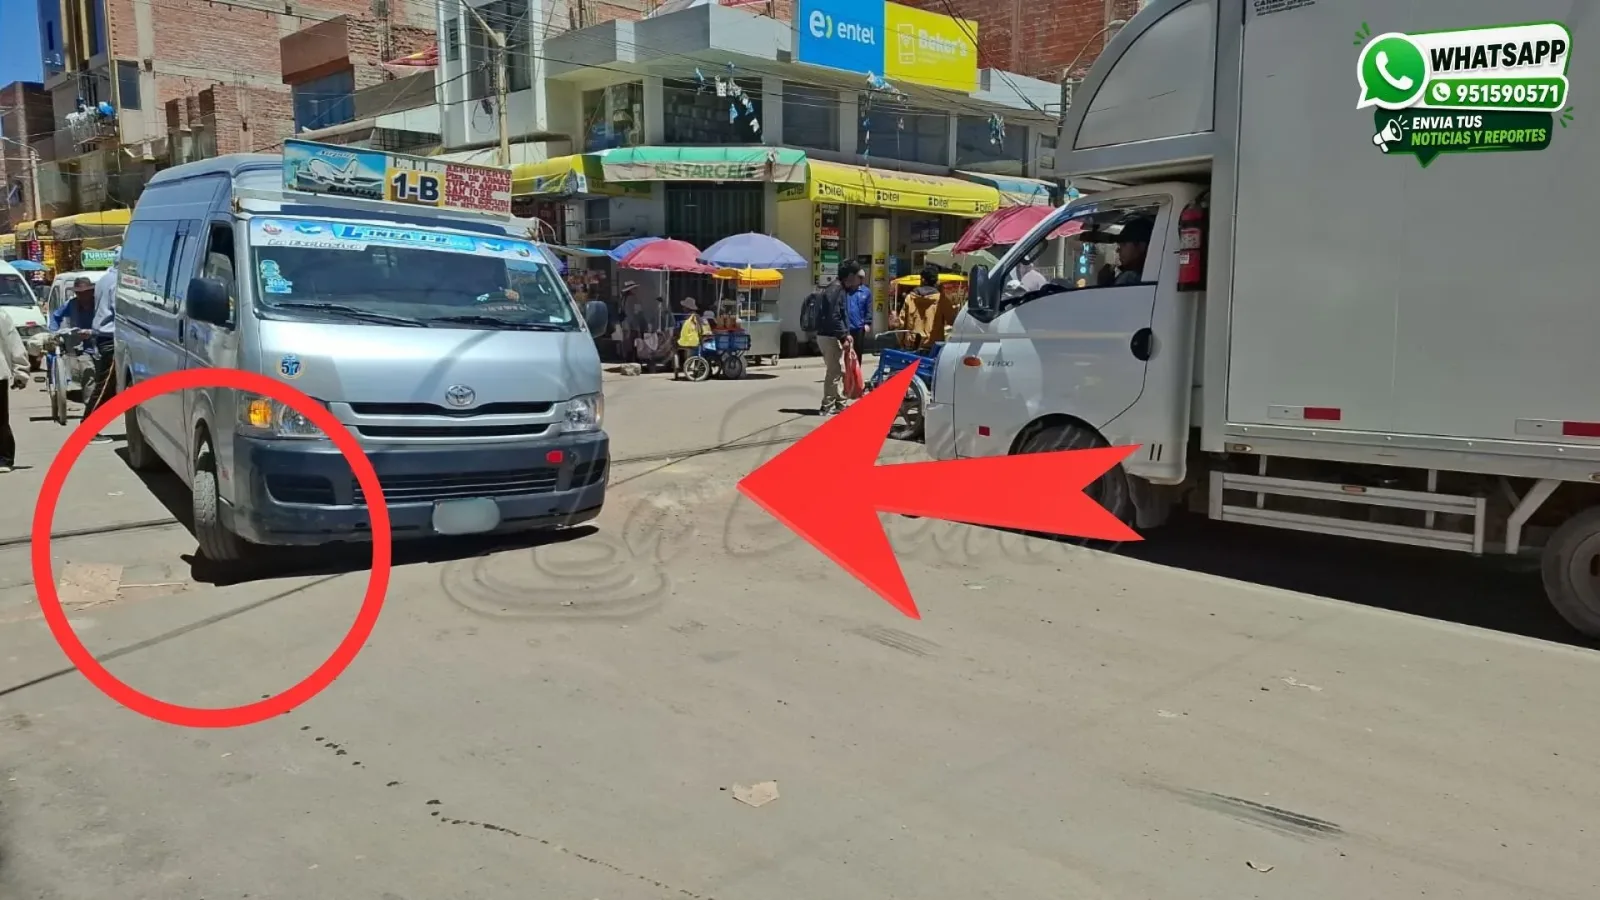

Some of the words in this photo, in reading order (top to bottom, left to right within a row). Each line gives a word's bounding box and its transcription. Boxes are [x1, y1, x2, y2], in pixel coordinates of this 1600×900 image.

[837, 21, 875, 45] entel
[447, 164, 510, 179] AEROPUERTO
[468, 174, 480, 182] DE
[393, 172, 439, 201] 1-B
[446, 185, 465, 195] SAN
[825, 184, 844, 197] bitel
[882, 190, 900, 203] bitel
[281, 360, 300, 375] 57
